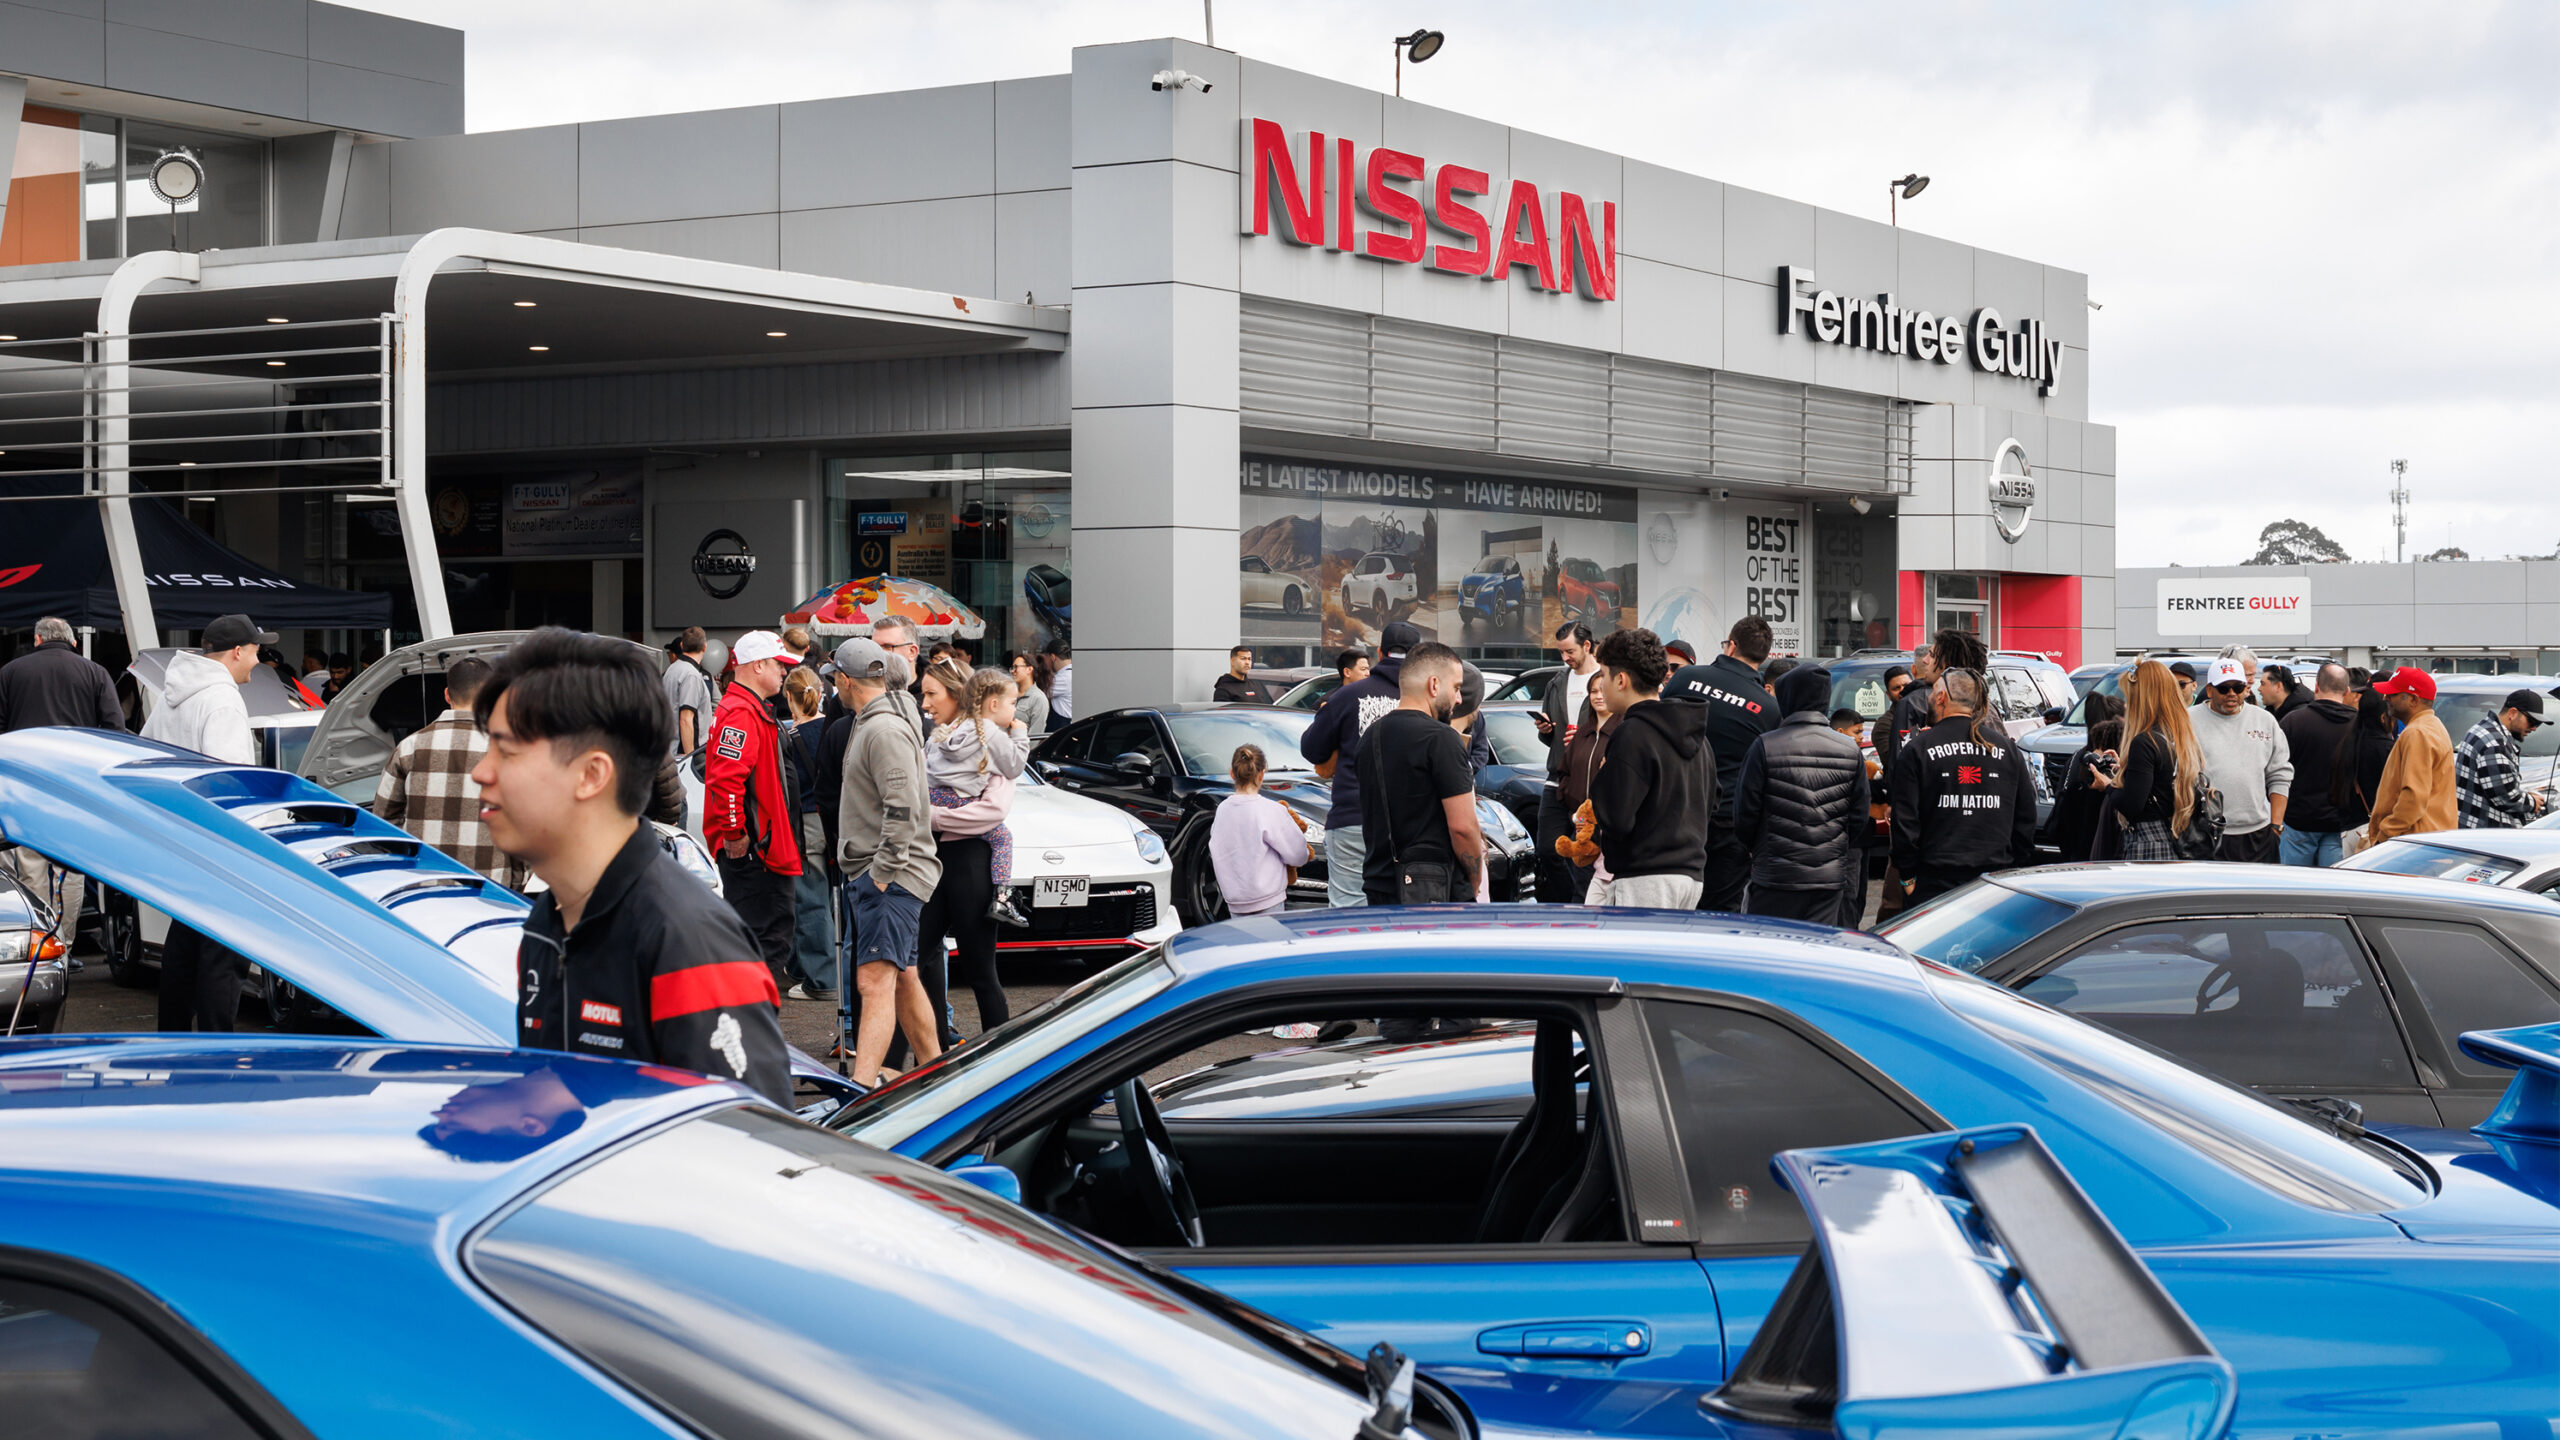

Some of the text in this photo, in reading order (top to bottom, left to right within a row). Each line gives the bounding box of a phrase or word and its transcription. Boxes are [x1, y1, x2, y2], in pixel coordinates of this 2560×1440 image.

[1241, 117, 1616, 301] NISSAN
[1778, 265, 2065, 398] Ferntree Gully
[1240, 461, 1262, 488] HE
[1267, 463, 1341, 494] LATEST
[1347, 467, 1434, 500] MODELS
[1464, 480, 1515, 507] HAVE
[1519, 486, 1603, 514] ARRIVED!
[573, 516, 599, 531] Dealer
[1746, 515, 1800, 554] BEST
[694, 558, 748, 569] NISSAN
[1746, 555, 1800, 584] OF THE
[1746, 586, 1800, 623] BEST
[2168, 596, 2300, 611] FERNTREE GULLY
[1784, 639, 1800, 649] BEST
[2045, 650, 2063, 658] Gully
[1687, 679, 1763, 715] nismo
[1991, 747, 2006, 760] OF
[1938, 794, 2001, 809] JDM NATION
[1044, 879, 1086, 894] NISMO
[1059, 894, 1069, 906] Z
[582, 1003, 621, 1024] MOTUL
